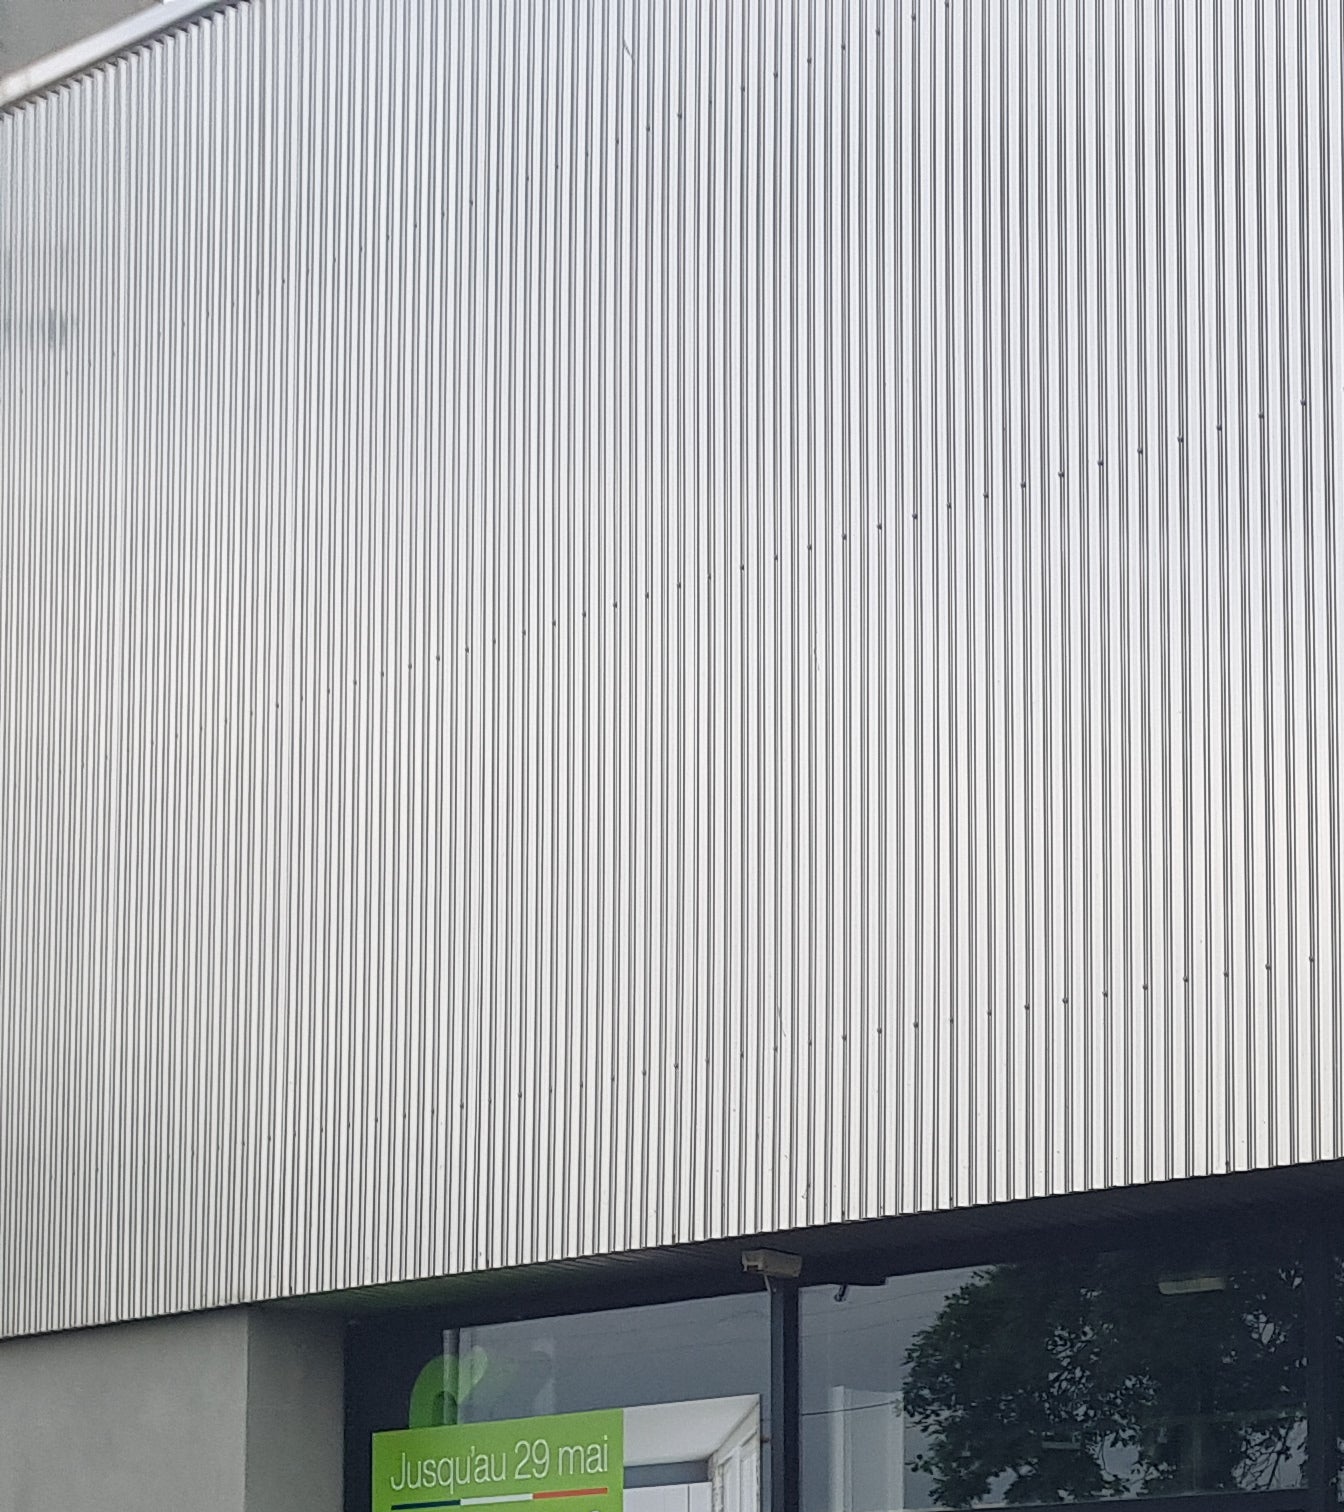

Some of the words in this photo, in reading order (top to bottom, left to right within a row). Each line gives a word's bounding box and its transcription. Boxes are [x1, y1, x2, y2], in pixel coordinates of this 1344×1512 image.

[390, 1440, 506, 1495] Jusqu'au
[513, 1438, 549, 1480] 29
[557, 1434, 609, 1476] mai
